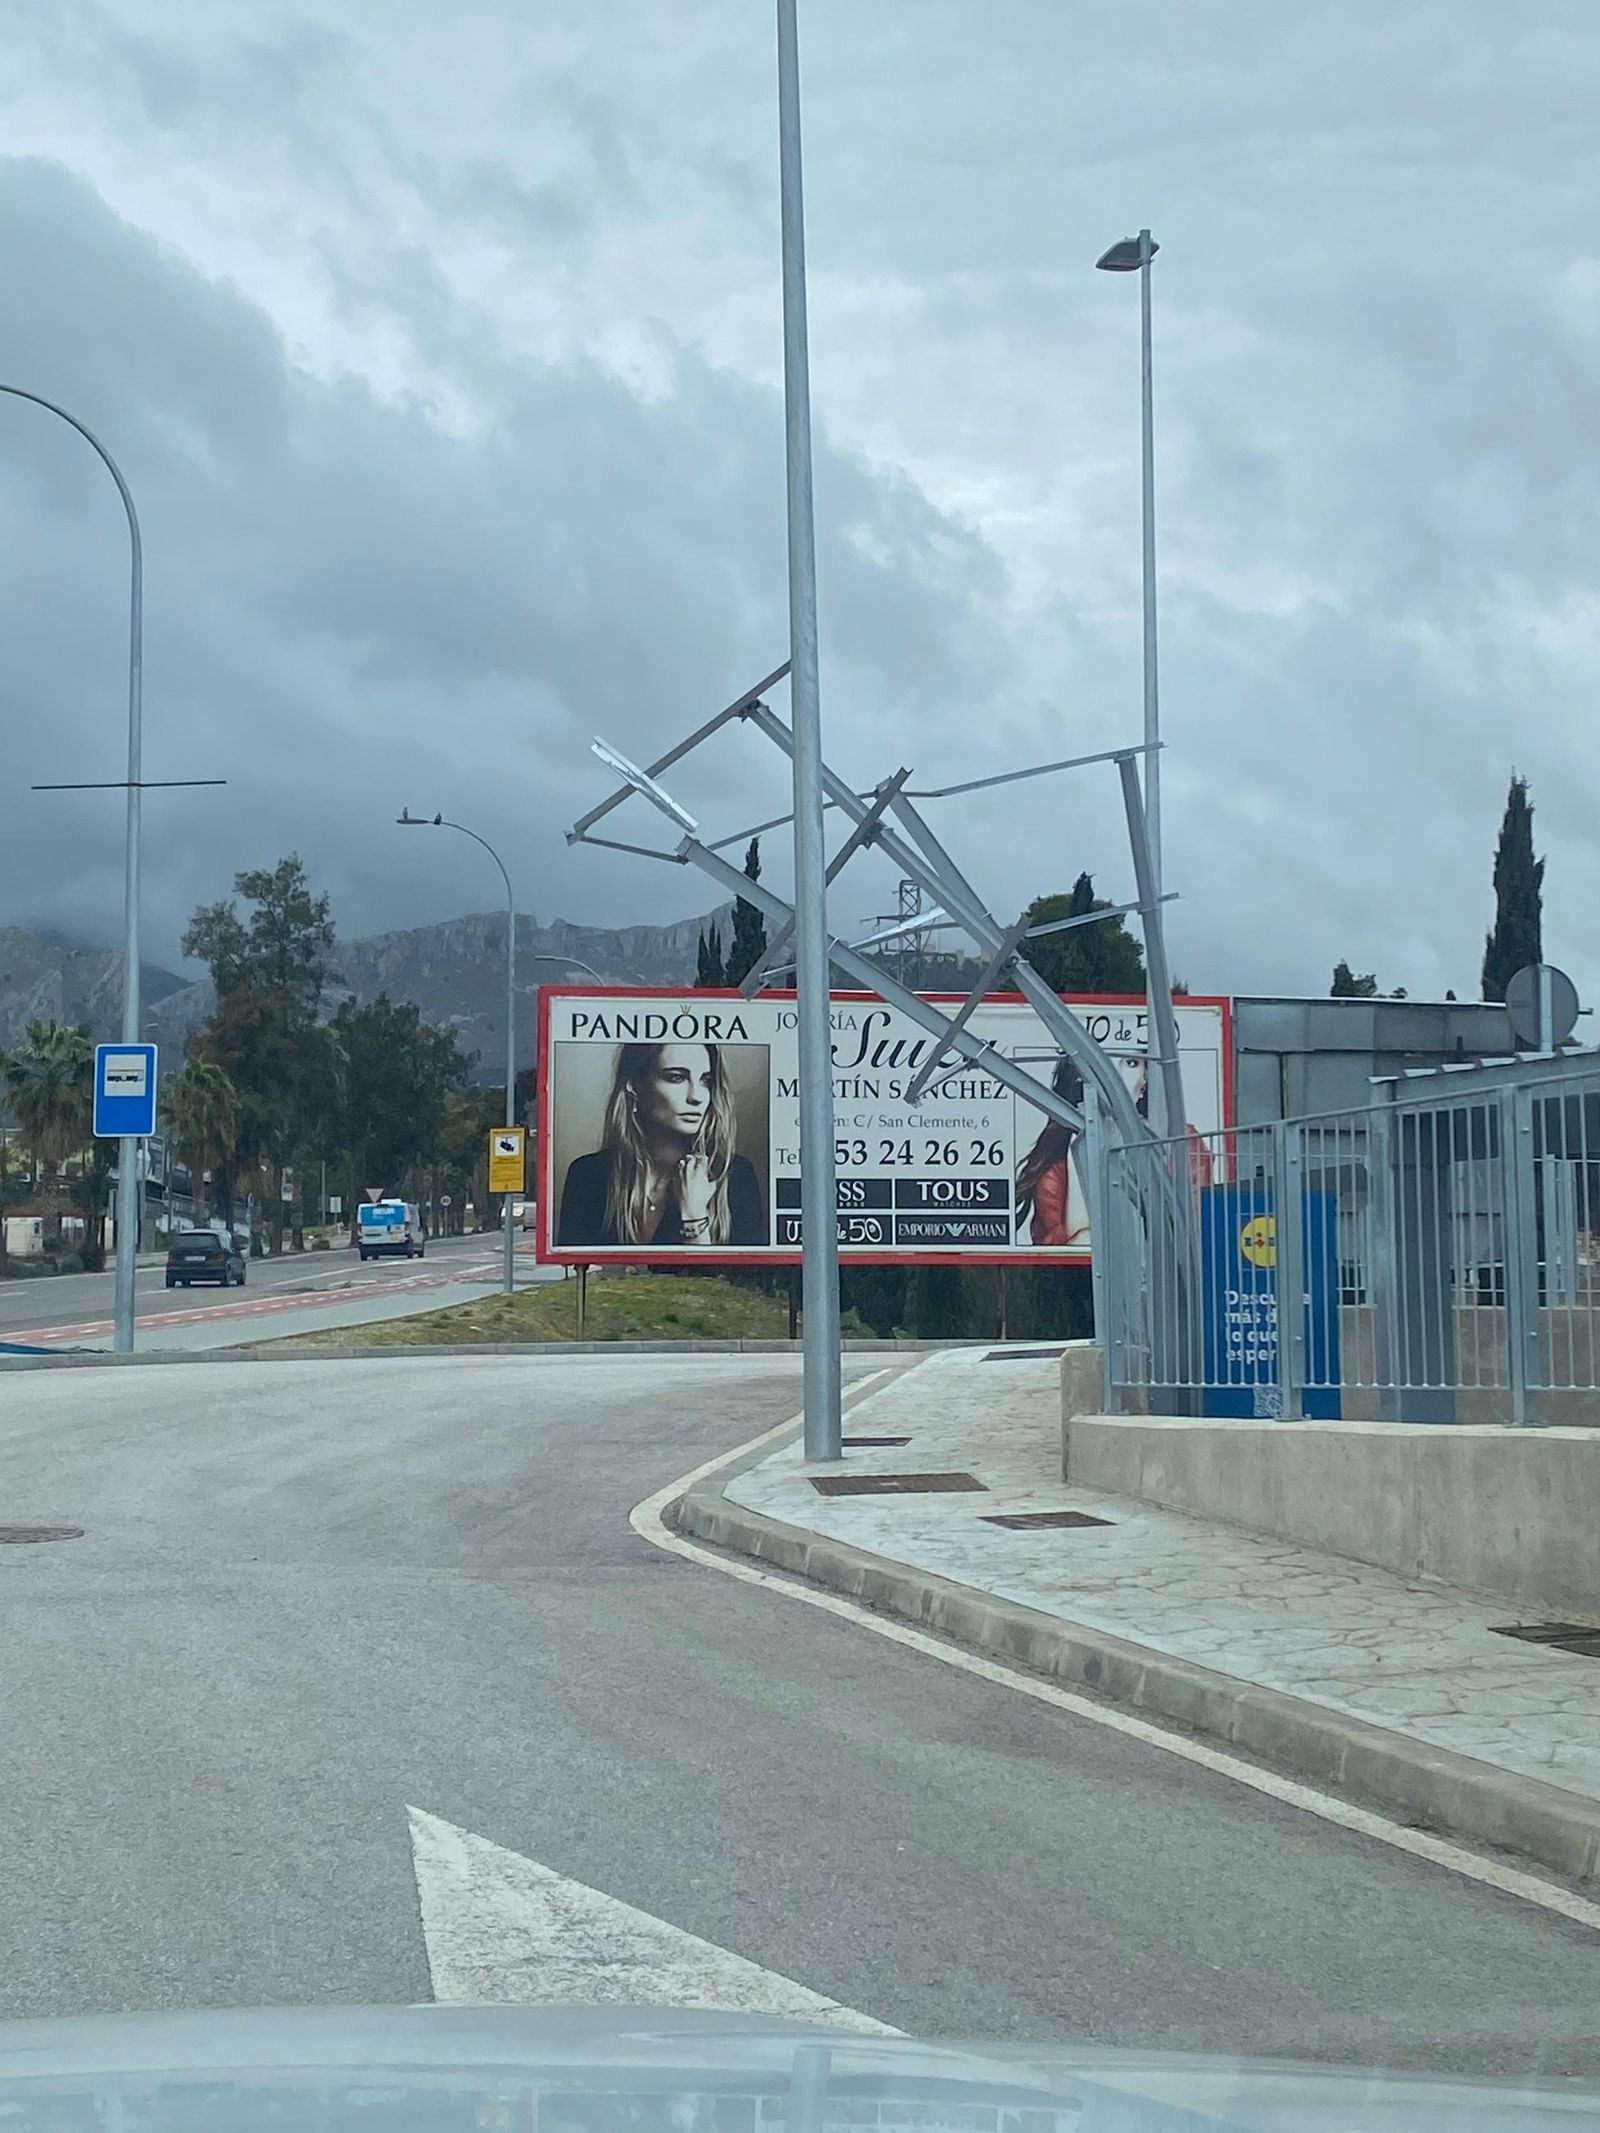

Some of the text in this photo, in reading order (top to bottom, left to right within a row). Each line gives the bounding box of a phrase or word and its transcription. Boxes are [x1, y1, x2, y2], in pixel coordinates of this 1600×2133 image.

[571, 1013, 749, 1040] PANDORA
[776, 1010, 858, 1031] JORÍA
[1114, 1019, 1132, 1041] de
[777, 1073, 1008, 1100] MTÍN SNCHEZ
[878, 1114, 904, 1128] San
[907, 1114, 978, 1130] Clemente,
[981, 1114, 990, 1128] 6
[835, 1139, 868, 1165] 53
[878, 1139, 914, 1166] 24
[924, 1139, 960, 1166] 26
[969, 1139, 1005, 1166] 26
[836, 1181, 866, 1201] SS
[916, 1181, 990, 1202] TOUS
[898, 1223, 1007, 1237] EMPORIO ARMANI
[1225, 1290, 1312, 1306] Descue
[1225, 1308, 1278, 1324] más d
[1227, 1349, 1276, 1365] esper
